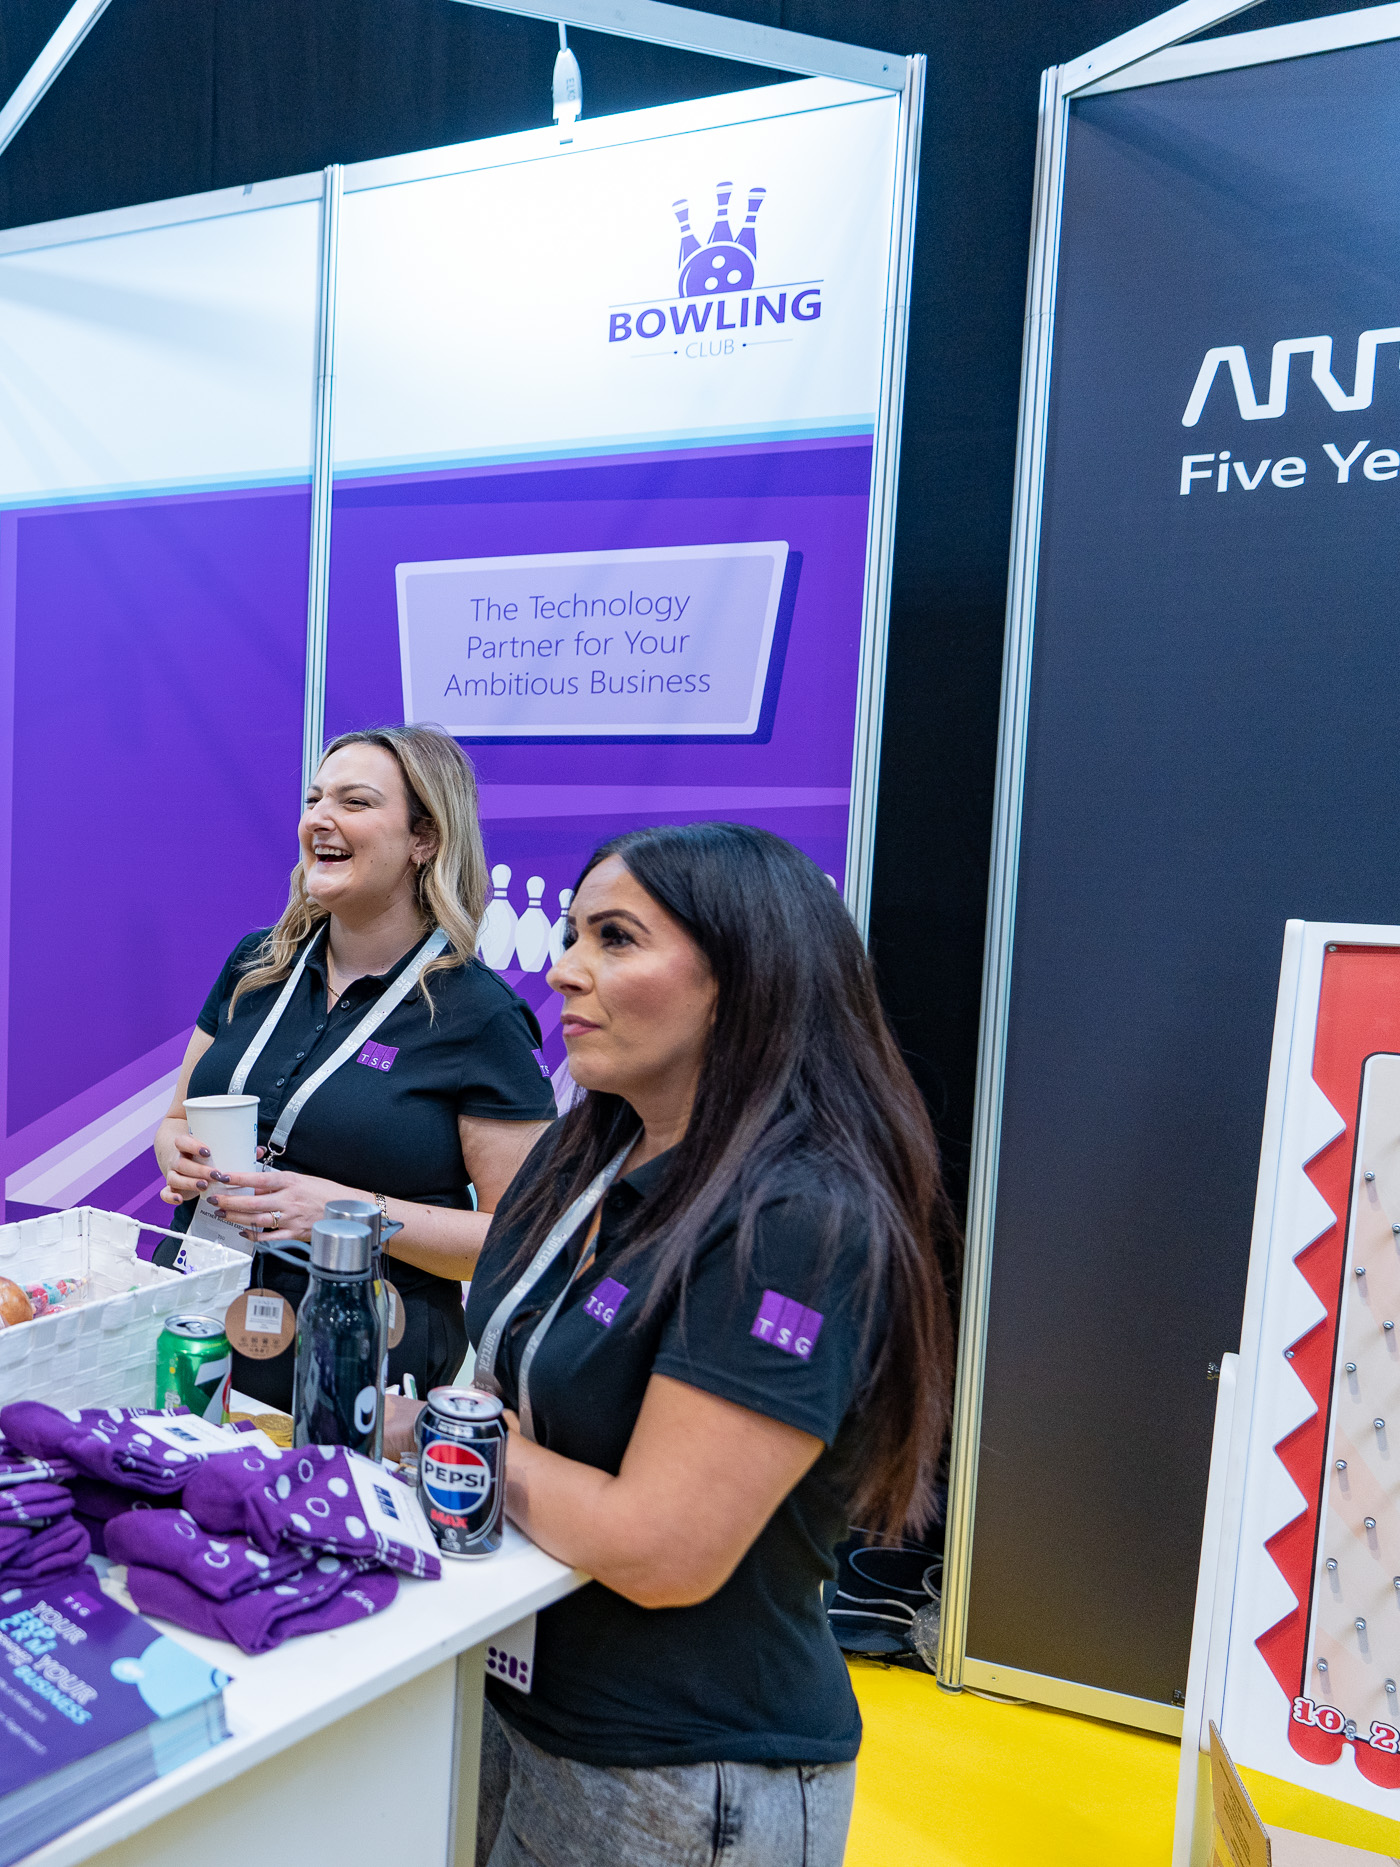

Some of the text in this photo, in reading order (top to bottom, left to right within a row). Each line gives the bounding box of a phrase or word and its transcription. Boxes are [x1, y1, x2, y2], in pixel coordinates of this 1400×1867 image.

[609, 288, 822, 343] BOWLING
[685, 338, 736, 359] CLUB
[1179, 450, 1308, 496] Five
[470, 590, 691, 622] The Technology
[467, 629, 691, 660] Partner for Your
[443, 669, 711, 698] Ambitious Business
[360, 1053, 391, 1070] TSG
[200, 1209, 217, 1219] PARTNER
[587, 1295, 615, 1323] TSG
[759, 1317, 812, 1356] TSG
[425, 1460, 486, 1488] PEPSI
[430, 1508, 469, 1530] MAX
[64, 1595, 91, 1617] TSG
[30, 1600, 88, 1645] YOUR
[13, 1664, 92, 1725] BUSINESS
[33, 1653, 99, 1706] YOUR
